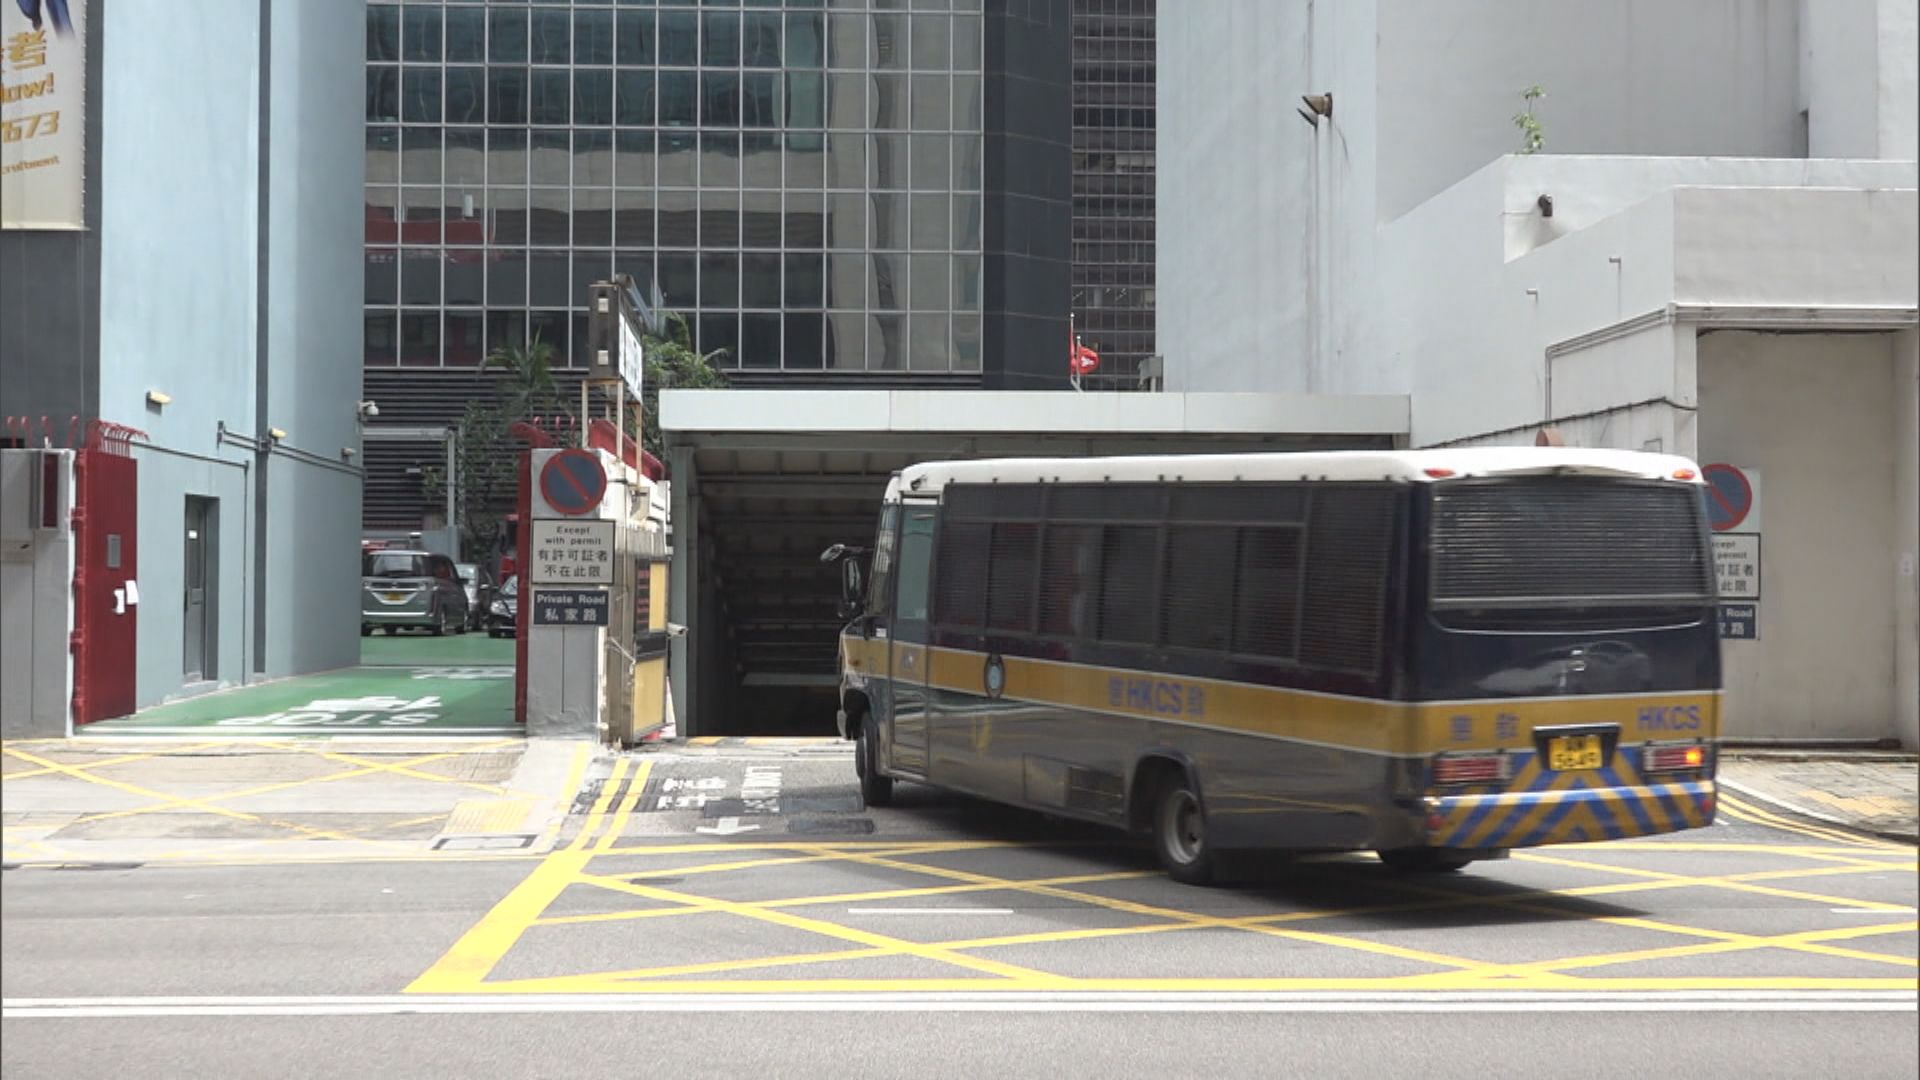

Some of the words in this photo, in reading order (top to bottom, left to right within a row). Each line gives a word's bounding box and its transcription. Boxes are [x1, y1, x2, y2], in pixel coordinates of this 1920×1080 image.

[2, 155, 60, 175] cruitment
[556, 526, 591, 535] Except
[545, 536, 565, 545] with
[570, 537, 601, 546] permit
[538, 548, 608, 561] 有許可証者
[1717, 551, 1747, 560] permit
[544, 564, 601, 577] 不在此限
[1715, 563, 1754, 577] 可証者
[1720, 580, 1747, 592] 此限
[537, 594, 573, 604] Private
[578, 594, 606, 605] Road
[544, 607, 597, 621] 私家路
[1726, 607, 1753, 618] Road
[1128, 680, 1184, 714] HKCS
[216, 711, 440, 726] STOP
[1639, 705, 1701, 731] HKCS
